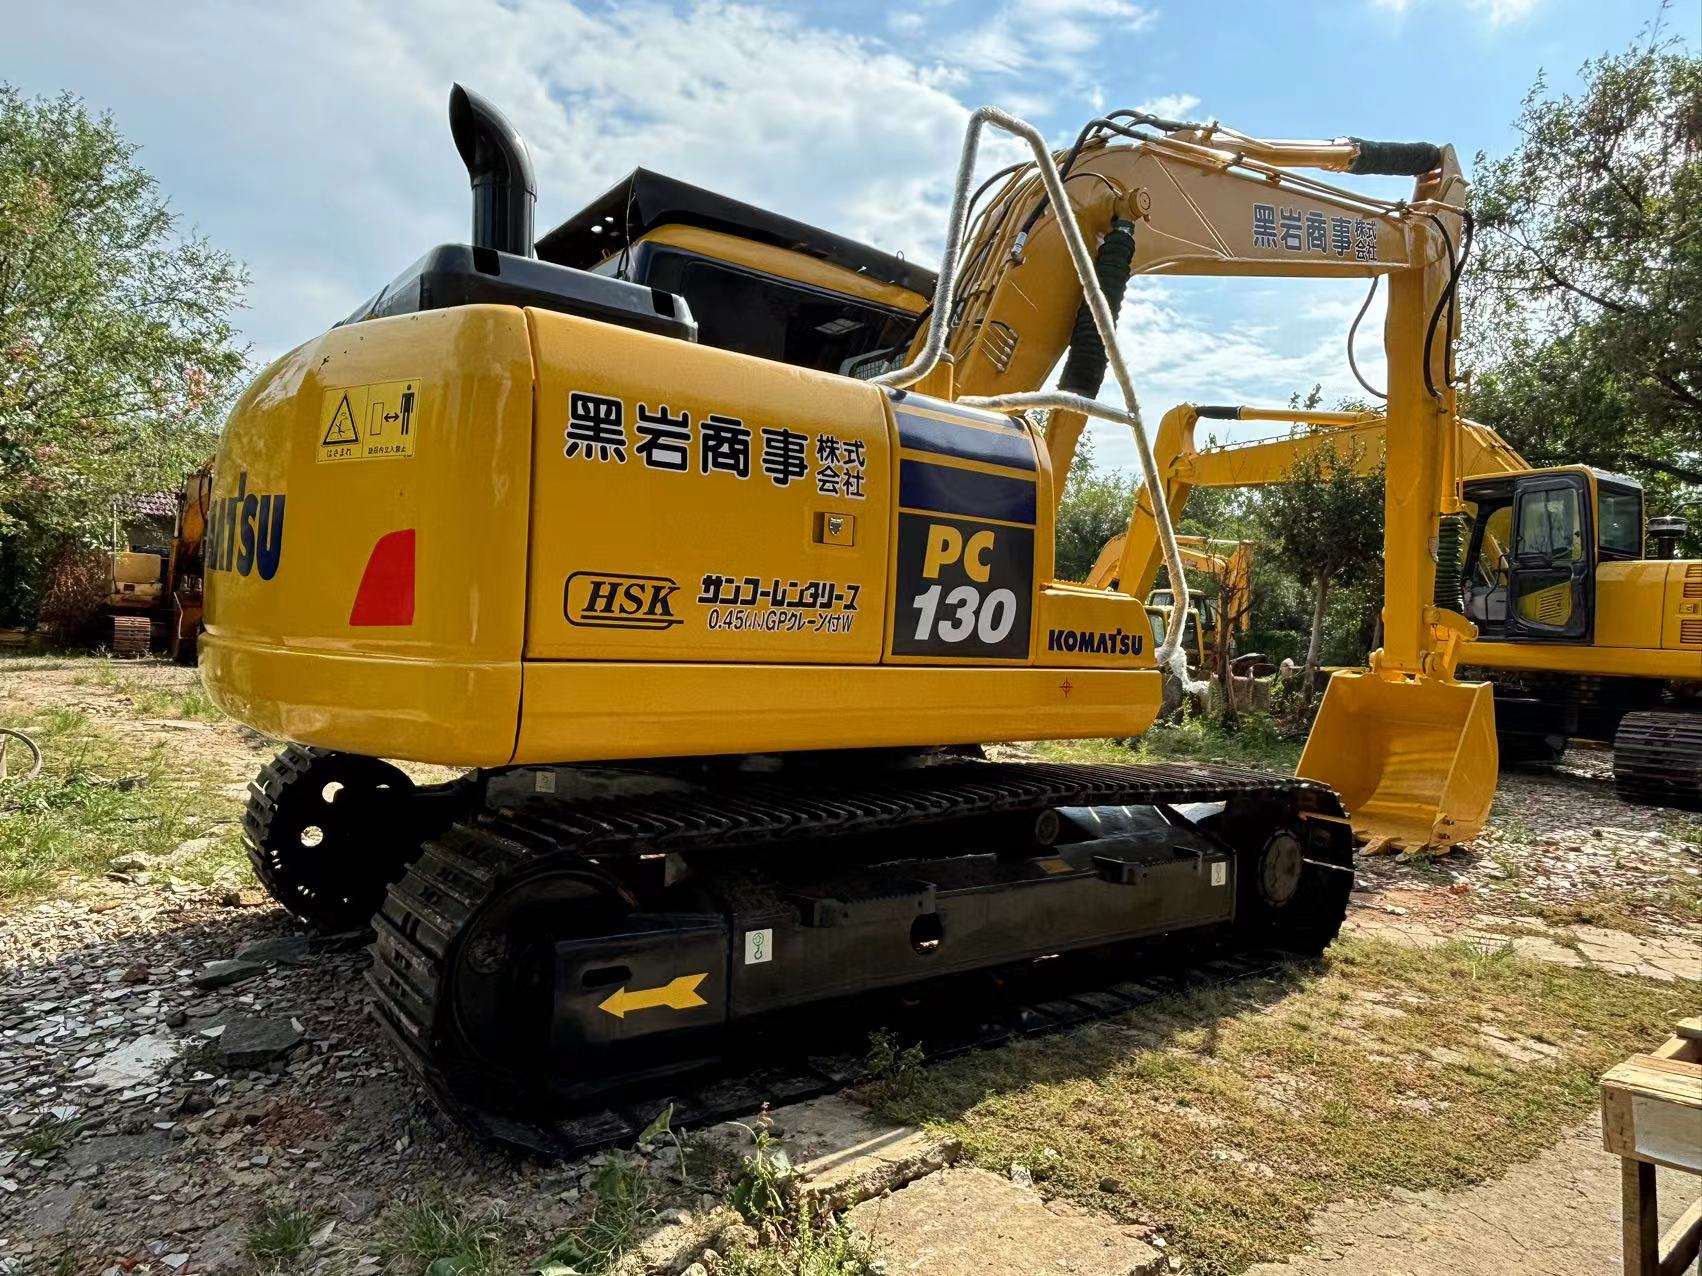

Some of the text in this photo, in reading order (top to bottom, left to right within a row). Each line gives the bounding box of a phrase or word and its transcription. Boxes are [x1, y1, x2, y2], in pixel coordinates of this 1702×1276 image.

[1253, 203, 1377, 257] 黒岩商事 株式
[327, 447, 352, 458] はさまれ
[563, 391, 866, 487] 黒岩商事 株式
[815, 463, 866, 499] 会社
[922, 523, 995, 583] PC
[583, 580, 681, 617] HSK
[697, 573, 862, 611] サンコーレンタリース
[912, 585, 1017, 644] 130
[1047, 627, 1143, 656] KOMATSU
